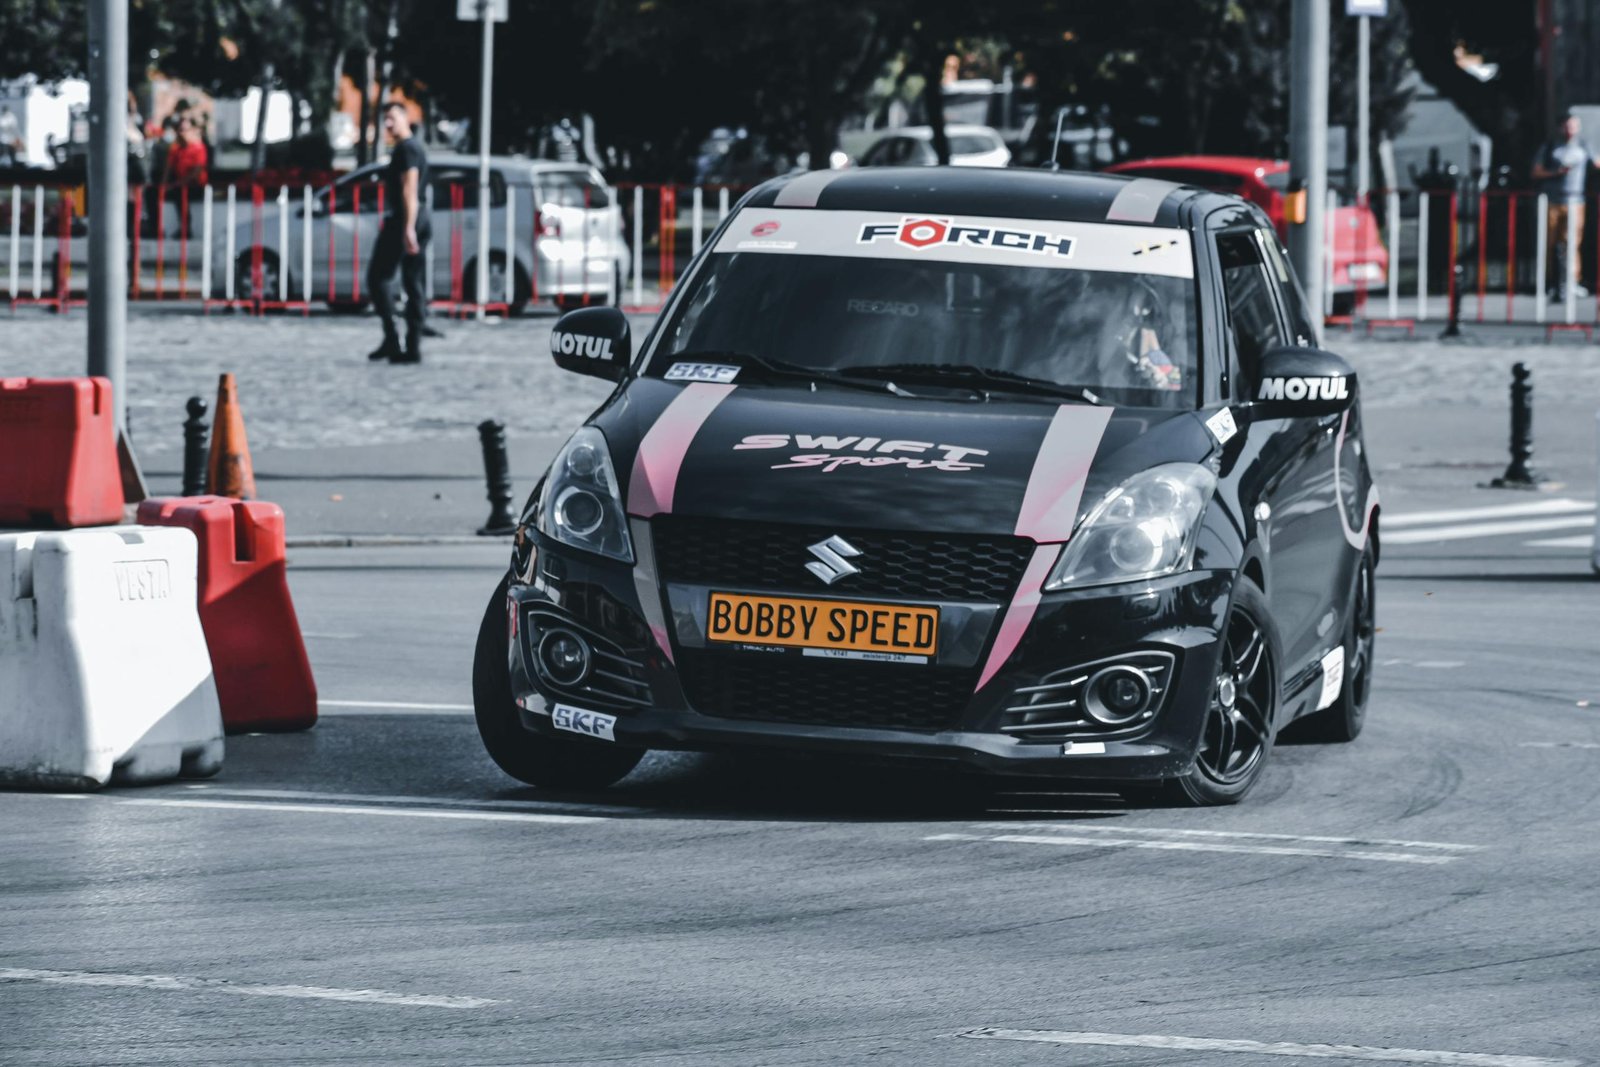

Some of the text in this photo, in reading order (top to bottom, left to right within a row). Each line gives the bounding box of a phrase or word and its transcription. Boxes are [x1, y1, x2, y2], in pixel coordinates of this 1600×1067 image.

[846, 299, 919, 317] RECARO
[551, 331, 614, 360] MOTUL
[668, 364, 738, 379] SKF
[1258, 376, 1349, 400] MOTUL
[732, 434, 989, 461] SWIFT
[114, 564, 169, 601] VESTA
[713, 600, 934, 648] BOBBY SPEED
[554, 708, 612, 735] SKF
